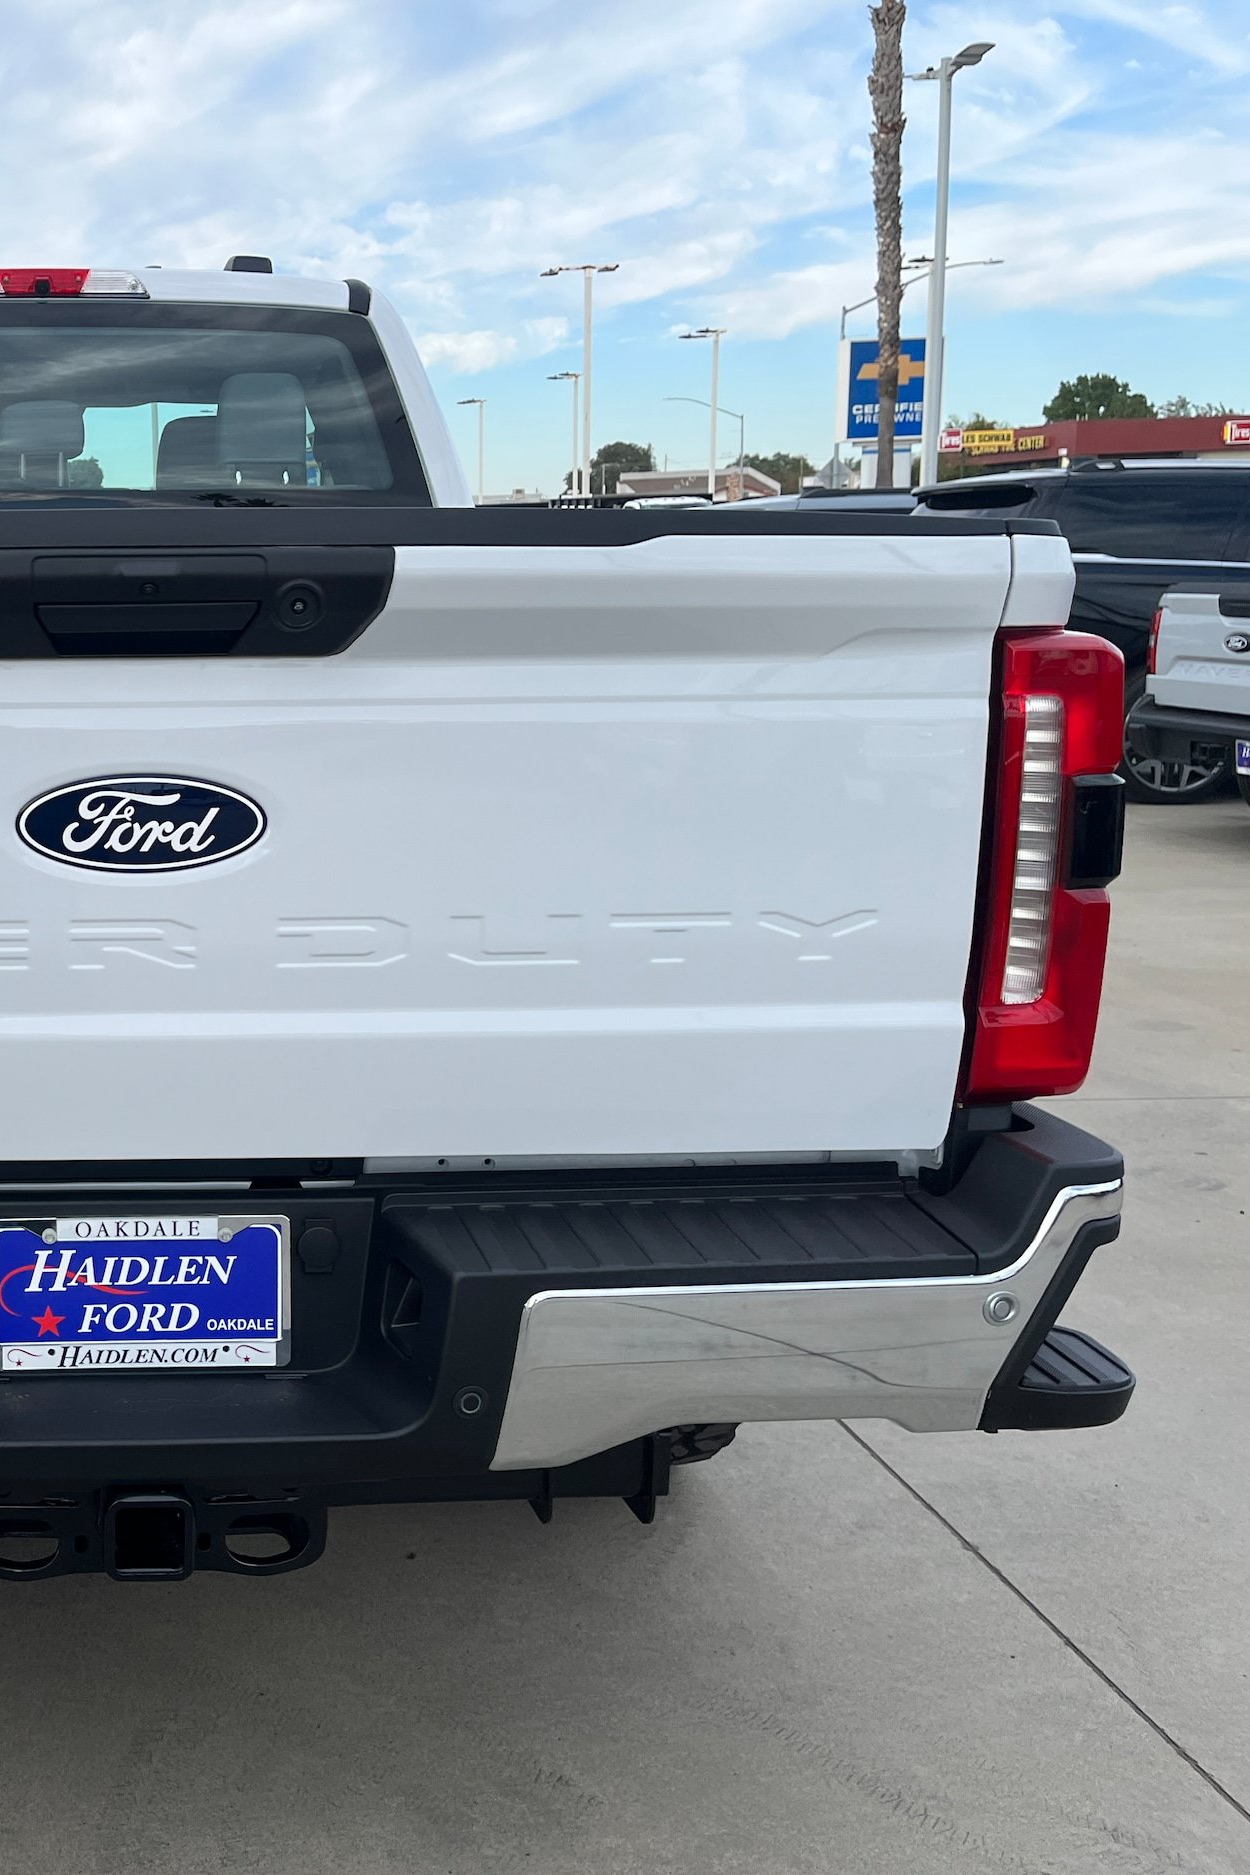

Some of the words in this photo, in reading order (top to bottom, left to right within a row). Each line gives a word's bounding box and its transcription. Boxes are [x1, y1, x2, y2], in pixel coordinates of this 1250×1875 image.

[978, 432, 1011, 443] SCHWAB
[62, 790, 220, 853] Ford
[276, 908, 879, 972] DUTY
[75, 1220, 200, 1238] OAKDALE
[24, 1249, 238, 1293] HAIDLEN
[77, 1303, 200, 1334] FORD
[206, 1318, 275, 1331] OAKDALE
[57, 1345, 221, 1368] HAIDLEN.COM
